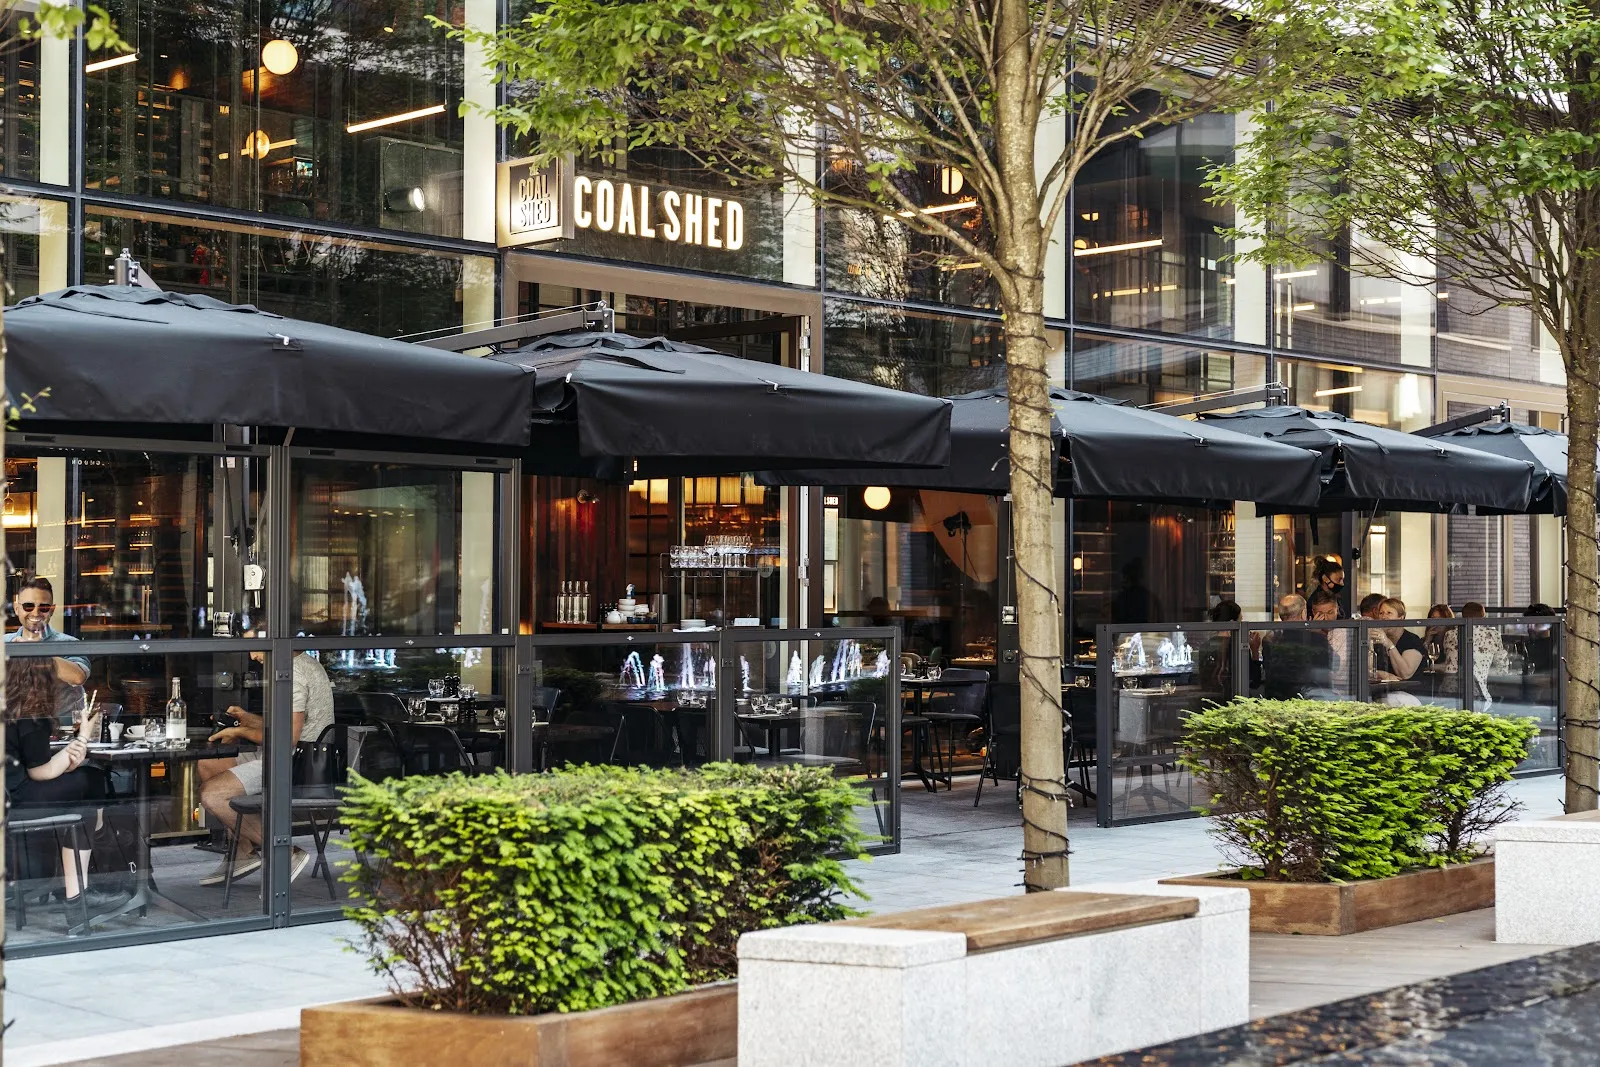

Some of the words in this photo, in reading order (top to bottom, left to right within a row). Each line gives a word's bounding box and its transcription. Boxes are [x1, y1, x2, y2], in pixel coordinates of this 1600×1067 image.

[519, 175, 550, 202] COAL
[521, 199, 551, 227] SHED
[574, 175, 655, 238] COAL
[661, 191, 744, 250] SHED
